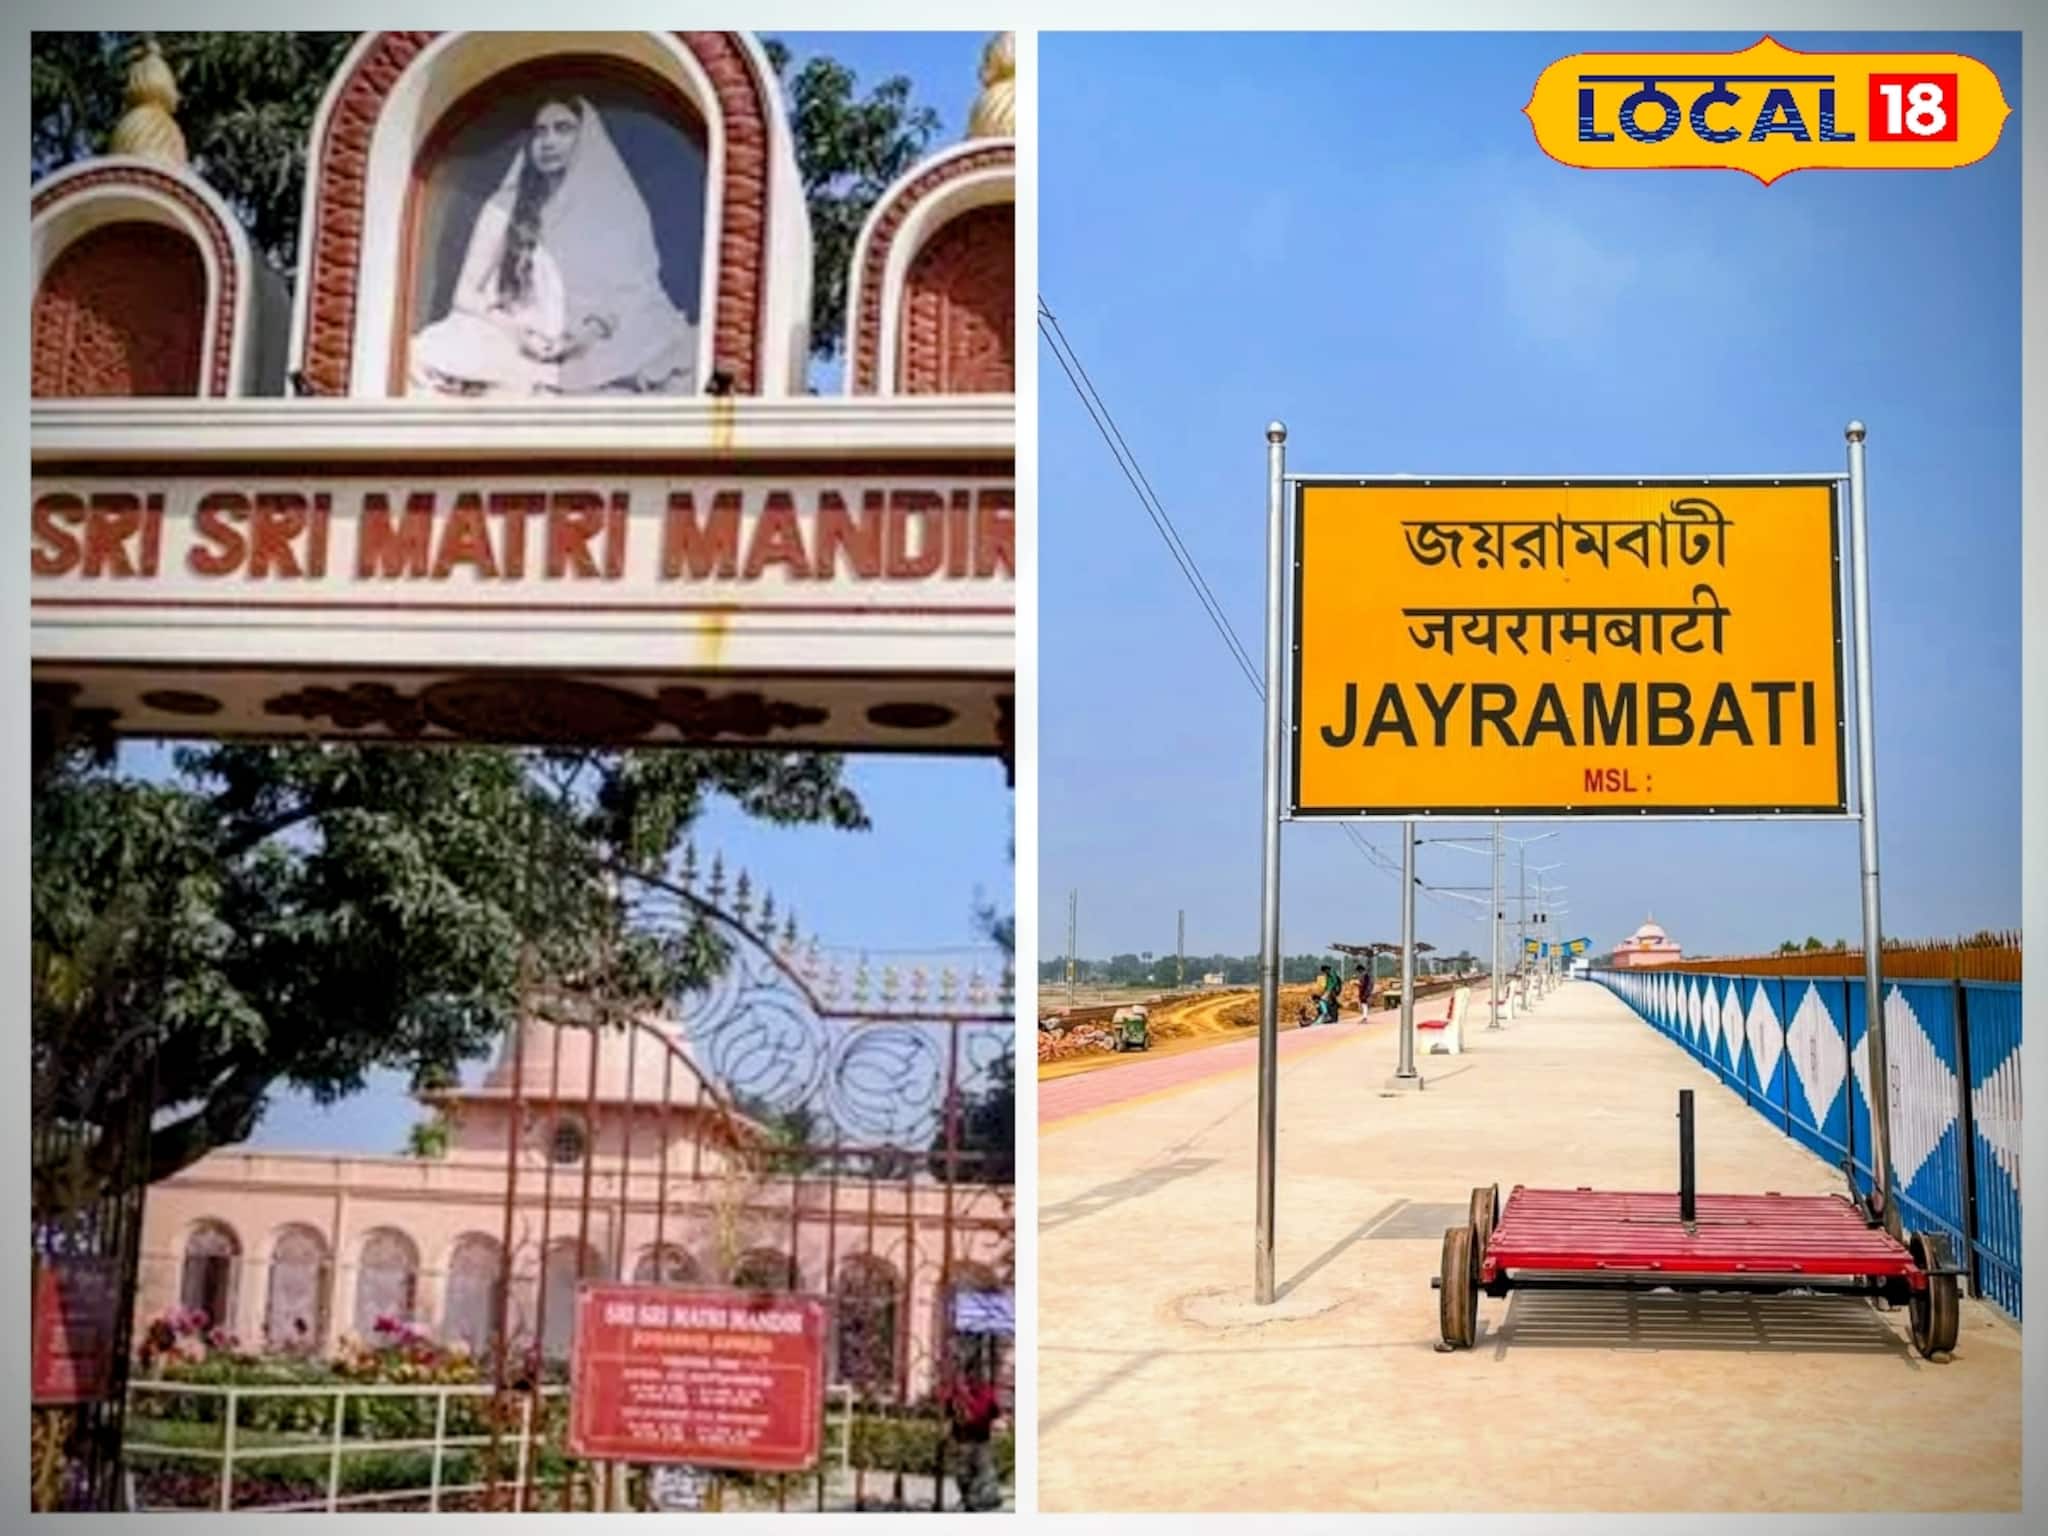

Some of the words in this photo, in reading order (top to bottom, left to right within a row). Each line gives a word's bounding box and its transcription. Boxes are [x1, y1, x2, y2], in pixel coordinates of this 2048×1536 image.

[31, 491, 164, 578] SRI
[186, 491, 332, 579] SRI
[355, 491, 630, 580] MATRI
[662, 488, 1015, 580] MANDIR
[1401, 497, 1733, 569] জয়রামবাটী
[1401, 583, 1731, 655] जयरामबाटी
[1320, 681, 1816, 748] JAYRAMBATI
[1584, 768, 1637, 793] MSL
